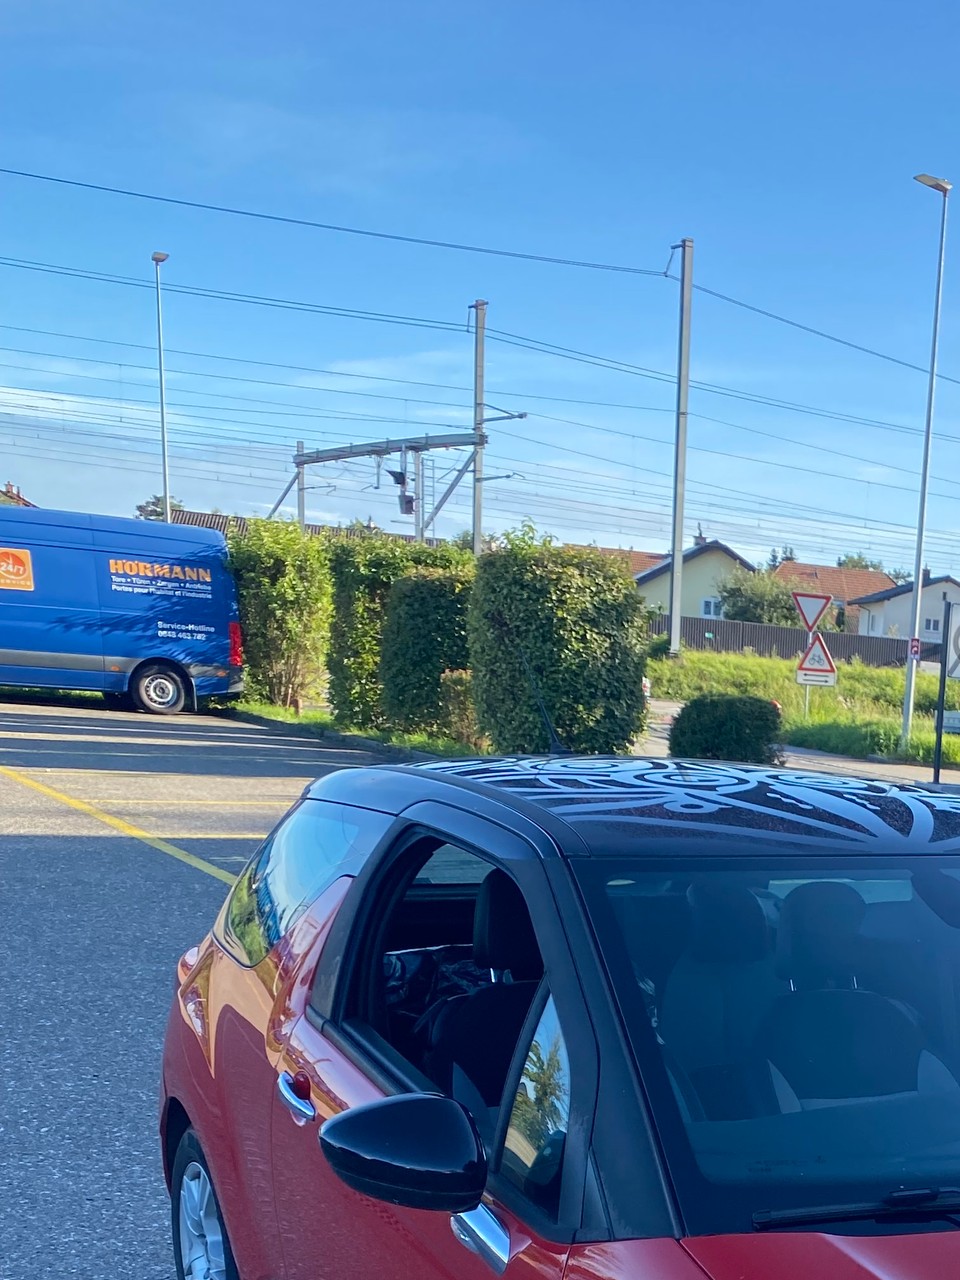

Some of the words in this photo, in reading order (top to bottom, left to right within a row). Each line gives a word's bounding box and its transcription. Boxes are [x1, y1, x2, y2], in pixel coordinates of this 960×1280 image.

[109, 559, 212, 582] HÖRMANN
[111, 575, 126, 583] Tore
[111, 584, 133, 592] Portes
[157, 621, 215, 632] Service-Hotline
